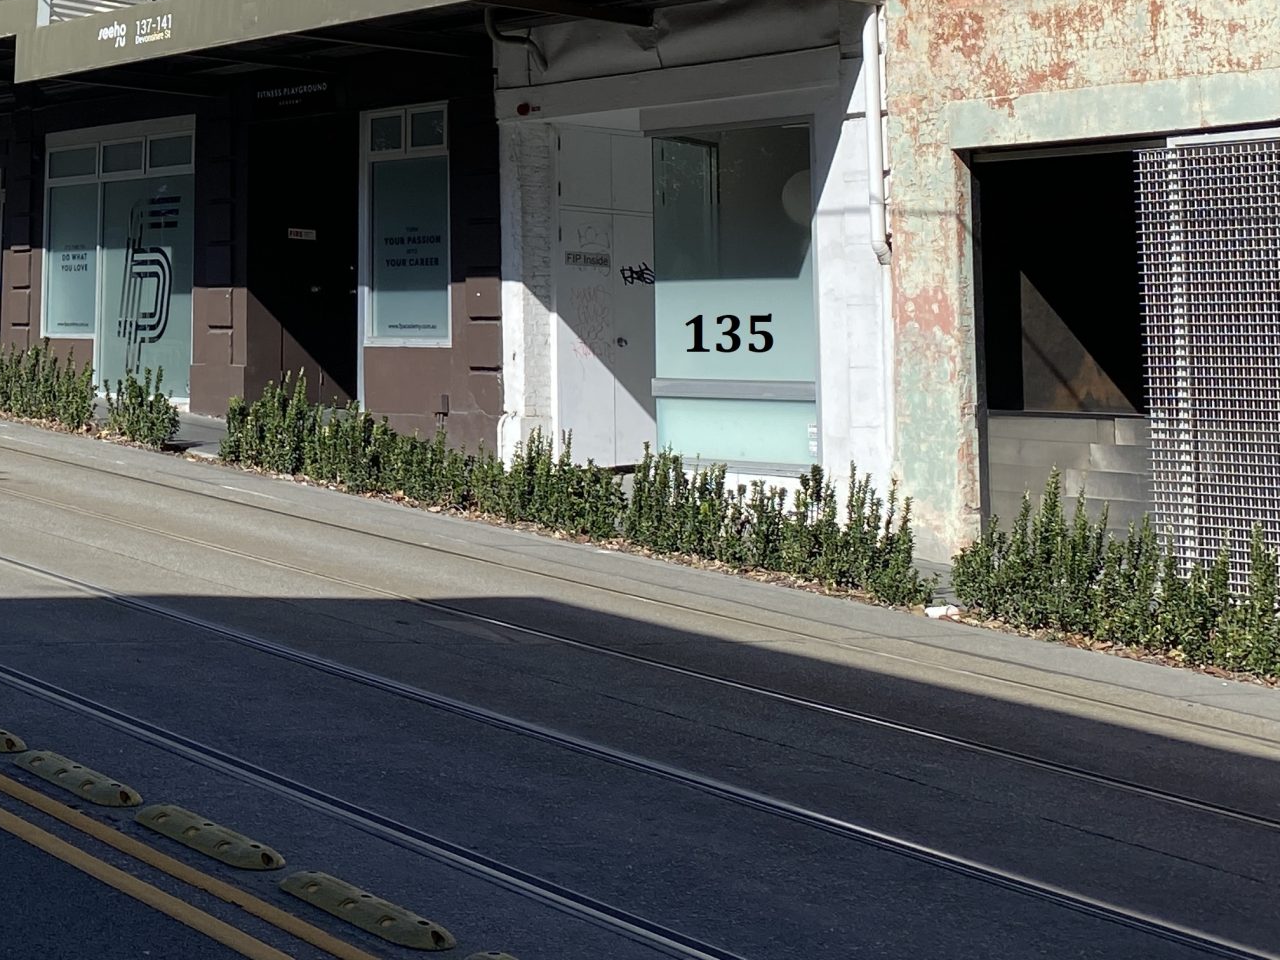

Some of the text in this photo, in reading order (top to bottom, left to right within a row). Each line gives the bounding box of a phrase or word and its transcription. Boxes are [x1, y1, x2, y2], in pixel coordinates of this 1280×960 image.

[135, 13, 172, 35] 137-141
[164, 29, 171, 39] St
[257, 82, 328, 99] FITNESS PLAYGROUND
[384, 235, 441, 246] YOUR PASSION
[386, 257, 439, 267] YOUR CAREER
[566, 253, 609, 266] FIP Inside
[685, 313, 774, 353] 135
